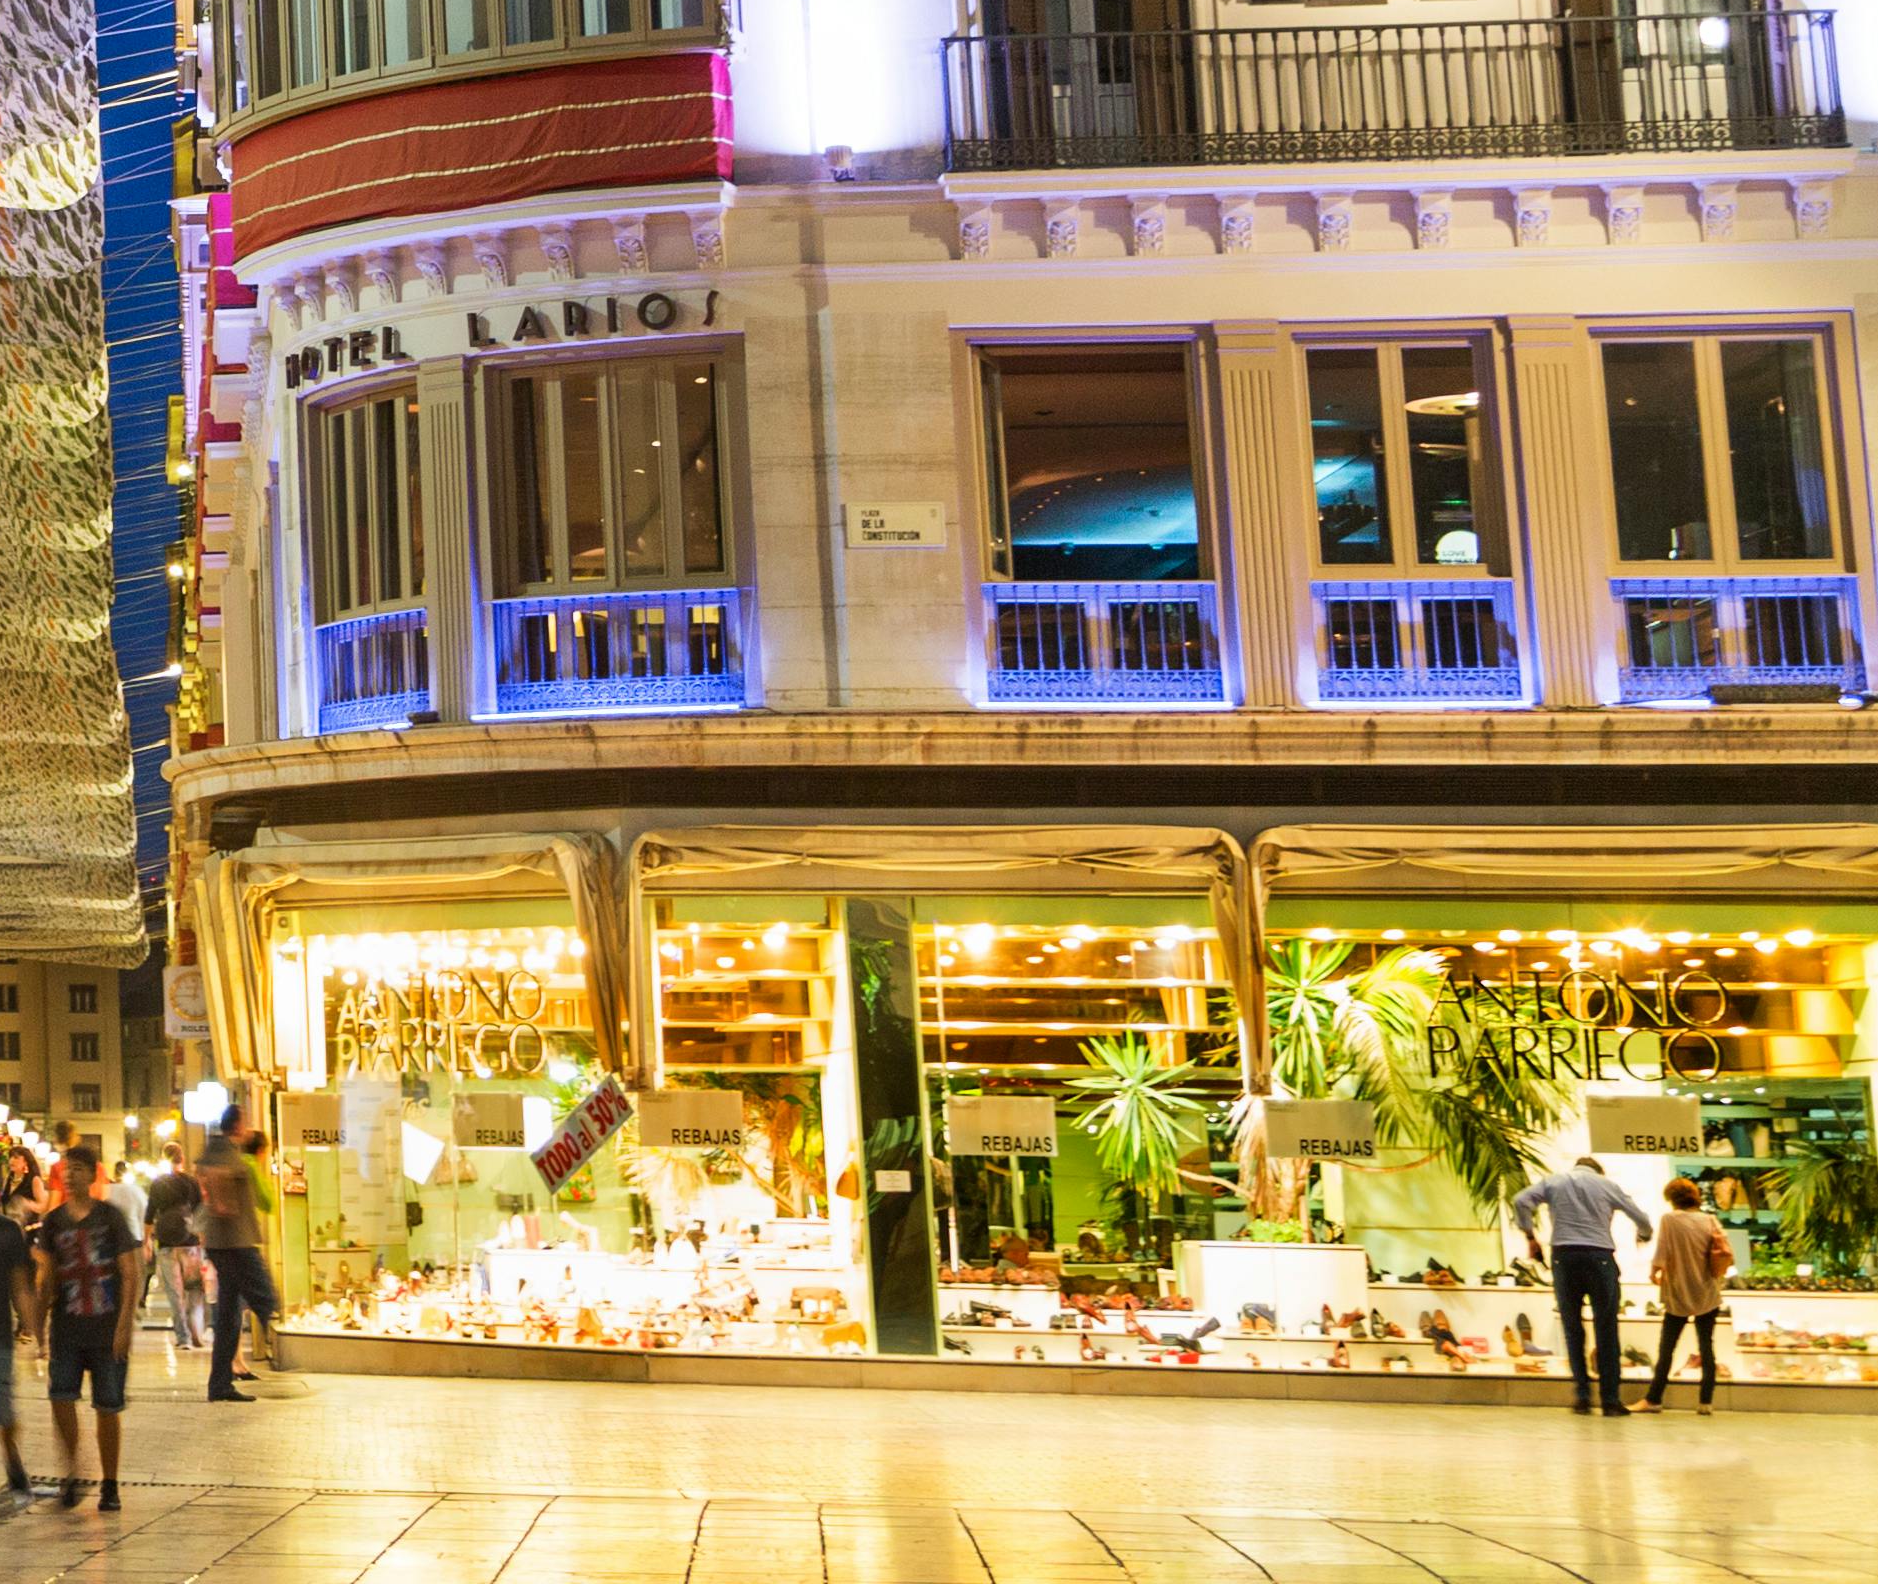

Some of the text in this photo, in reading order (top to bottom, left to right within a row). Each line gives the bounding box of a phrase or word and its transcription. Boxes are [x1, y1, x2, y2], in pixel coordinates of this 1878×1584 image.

[285, 290, 720, 390] HOTEL LARIOS
[862, 519, 885, 529] DE LA
[1428, 969, 1729, 1027] ANTONIO
[302, 1129, 347, 1145] REBAJAS
[475, 1129, 525, 1145] REBAJAS
[535, 1082, 629, 1186] TODO al 50%
[672, 1129, 741, 1145] REBAJAS
[981, 1135, 1053, 1153] REBAJAS
[1299, 1139, 1374, 1156] REBAJAS
[1624, 1135, 1700, 1153] REBAJAS
